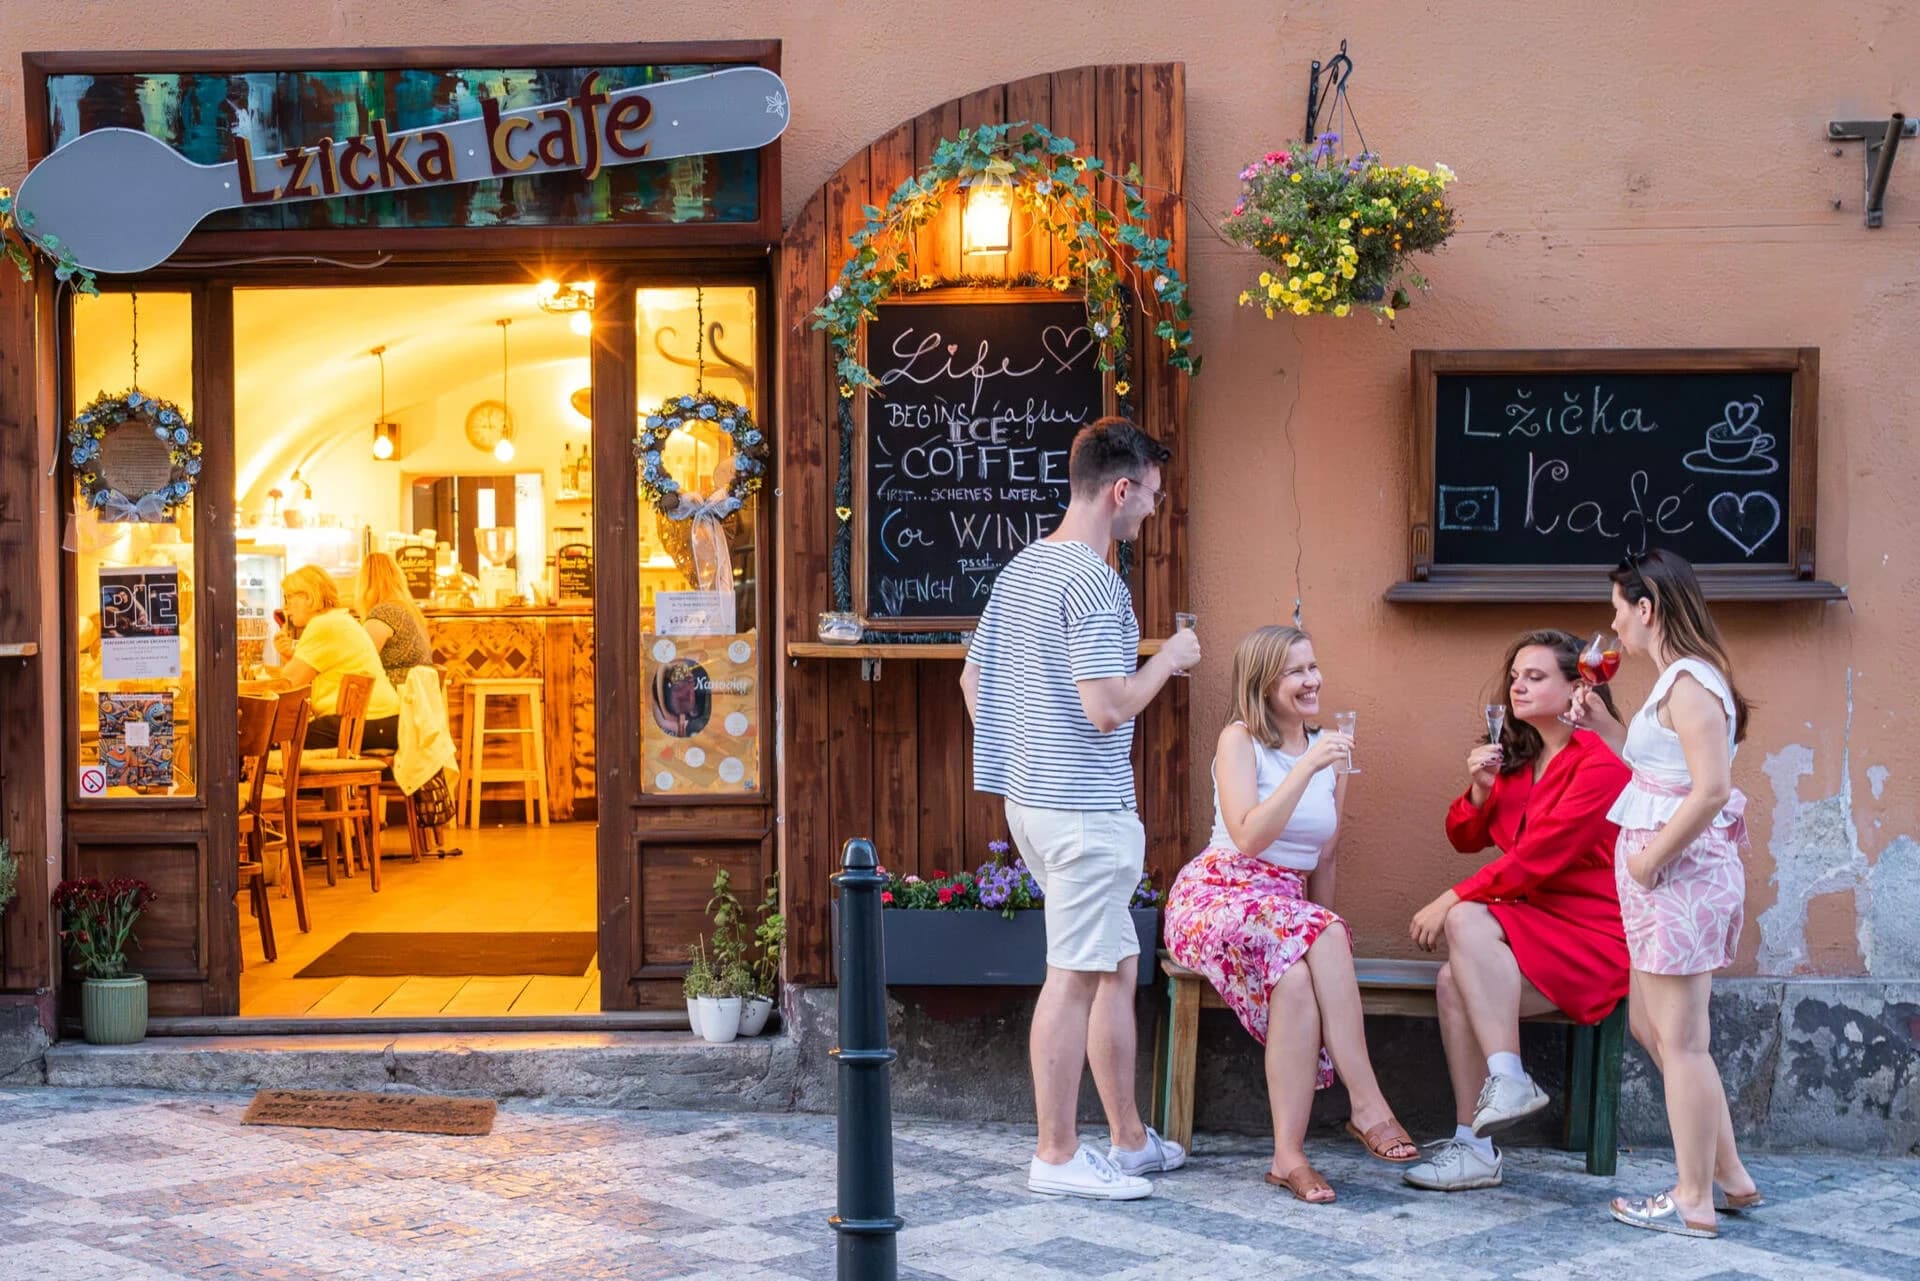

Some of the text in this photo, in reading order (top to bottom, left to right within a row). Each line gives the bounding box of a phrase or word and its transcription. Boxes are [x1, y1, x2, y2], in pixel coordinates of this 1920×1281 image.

[881, 327, 1044, 415] Life
[884, 402, 970, 429] BEGINS
[901, 442, 1068, 483] COFFEE
[930, 488, 993, 502] SCHEMES
[949, 511, 1059, 551] WINE
[102, 584, 178, 629] PIE
